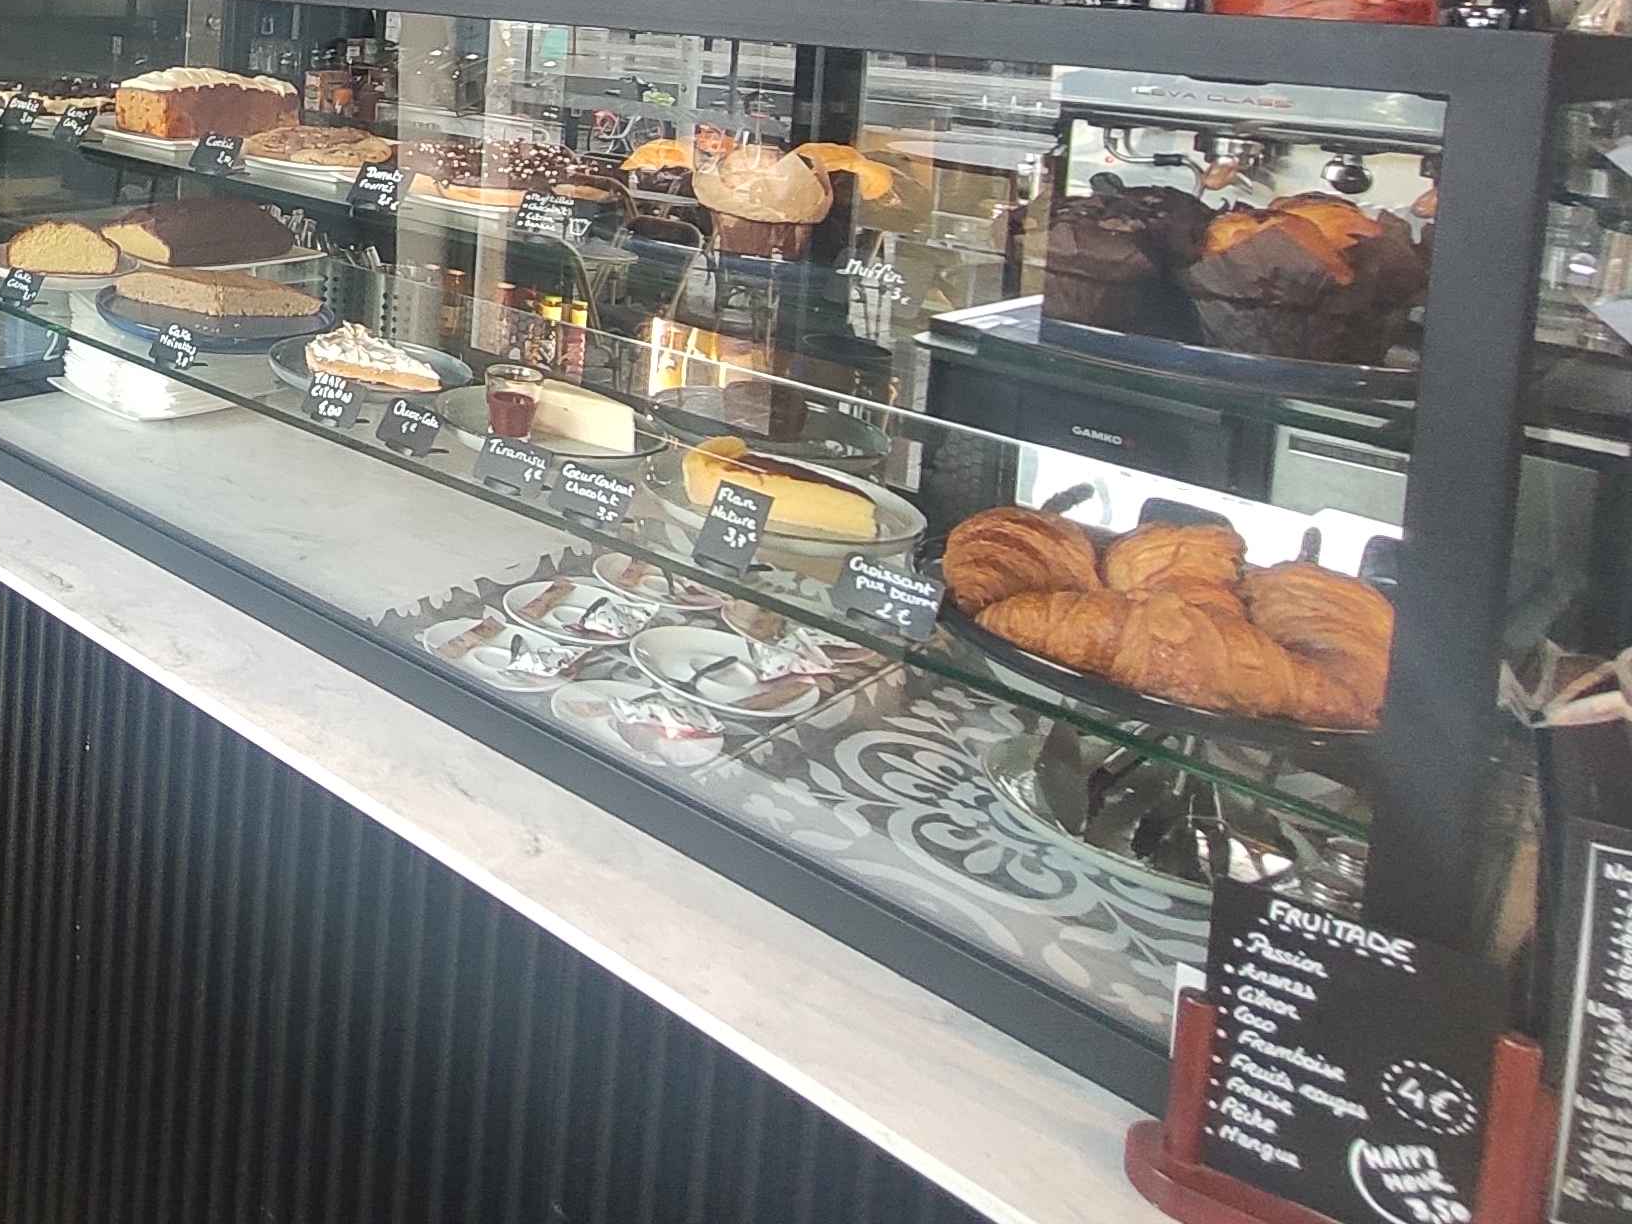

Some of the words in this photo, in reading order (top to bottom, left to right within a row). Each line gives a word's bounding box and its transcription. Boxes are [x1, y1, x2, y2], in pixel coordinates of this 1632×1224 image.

[205, 134, 235, 150] Cookie
[838, 258, 907, 285] Muffin
[169, 324, 193, 341] Cake
[1071, 425, 1122, 446] GAMKO
[489, 438, 547, 470] Tiramisu
[565, 480, 621, 507] Chocolat
[717, 487, 757, 512] Flan
[711, 504, 757, 530] Nature
[849, 556, 937, 597] Croissant
[1246, 931, 1330, 980] Passion
[1232, 1005, 1279, 1034] Coco
[1237, 1029, 1348, 1083] Framboise
